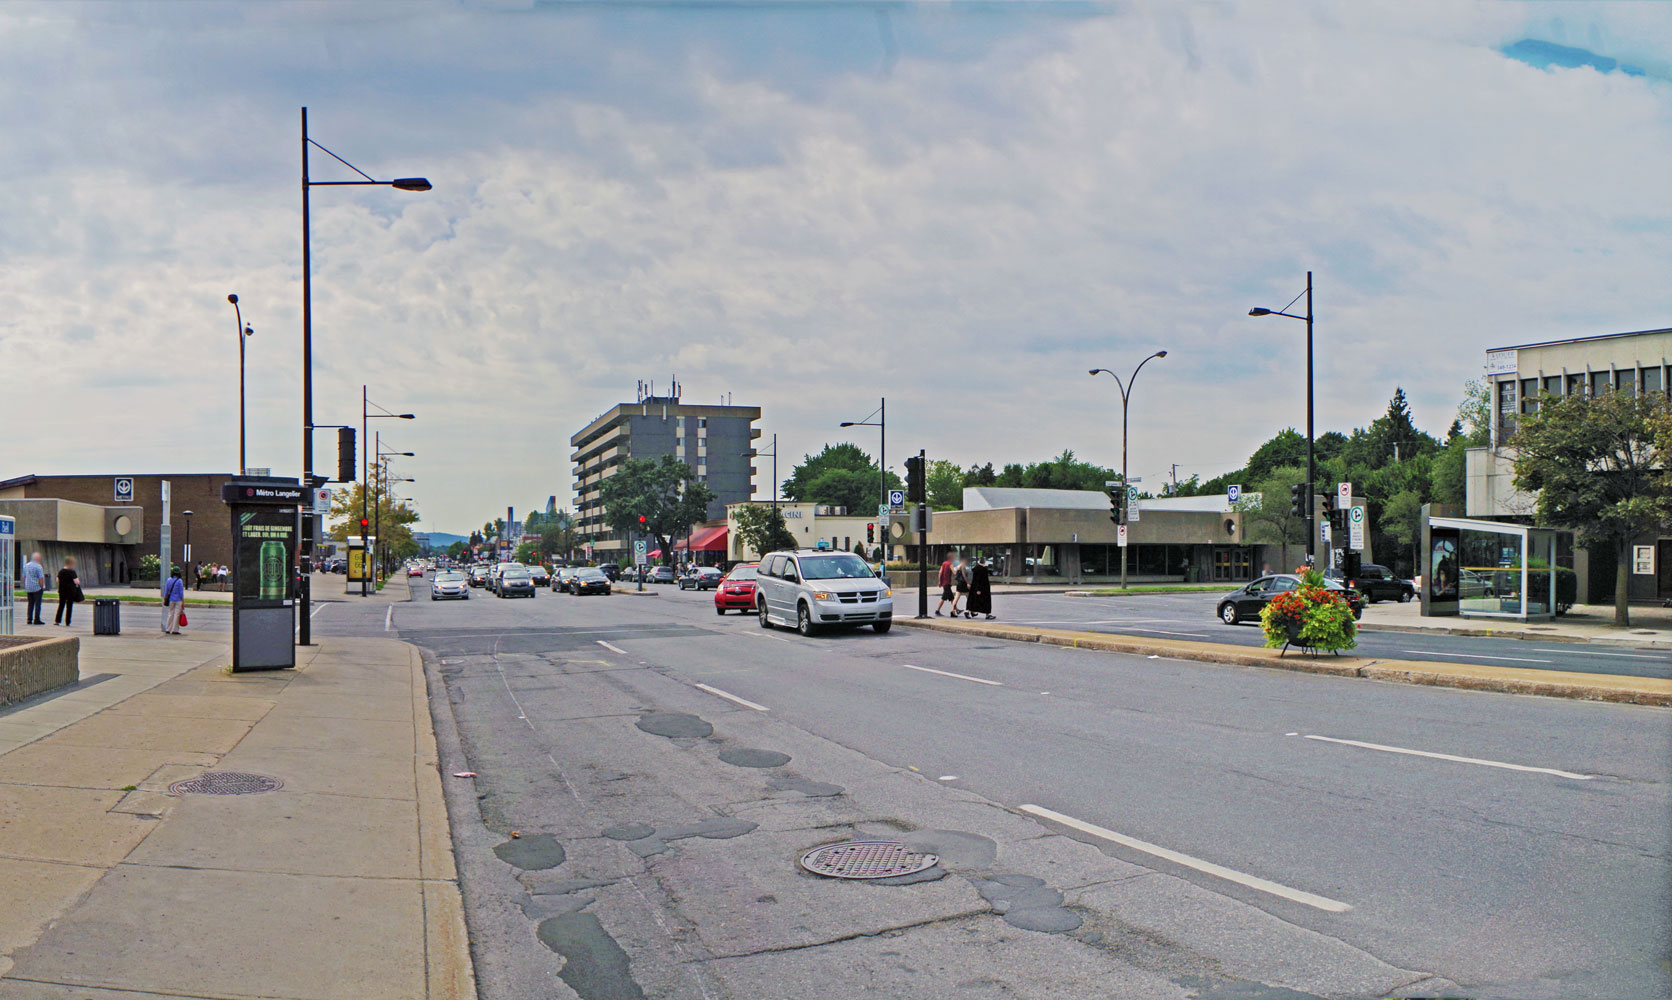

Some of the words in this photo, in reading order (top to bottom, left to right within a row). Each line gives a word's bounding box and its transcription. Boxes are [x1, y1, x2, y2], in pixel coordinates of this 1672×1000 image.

[256, 489, 274, 497] Métro
[275, 490, 301, 499] Langelier
[1, 521, 9, 533] Bell
